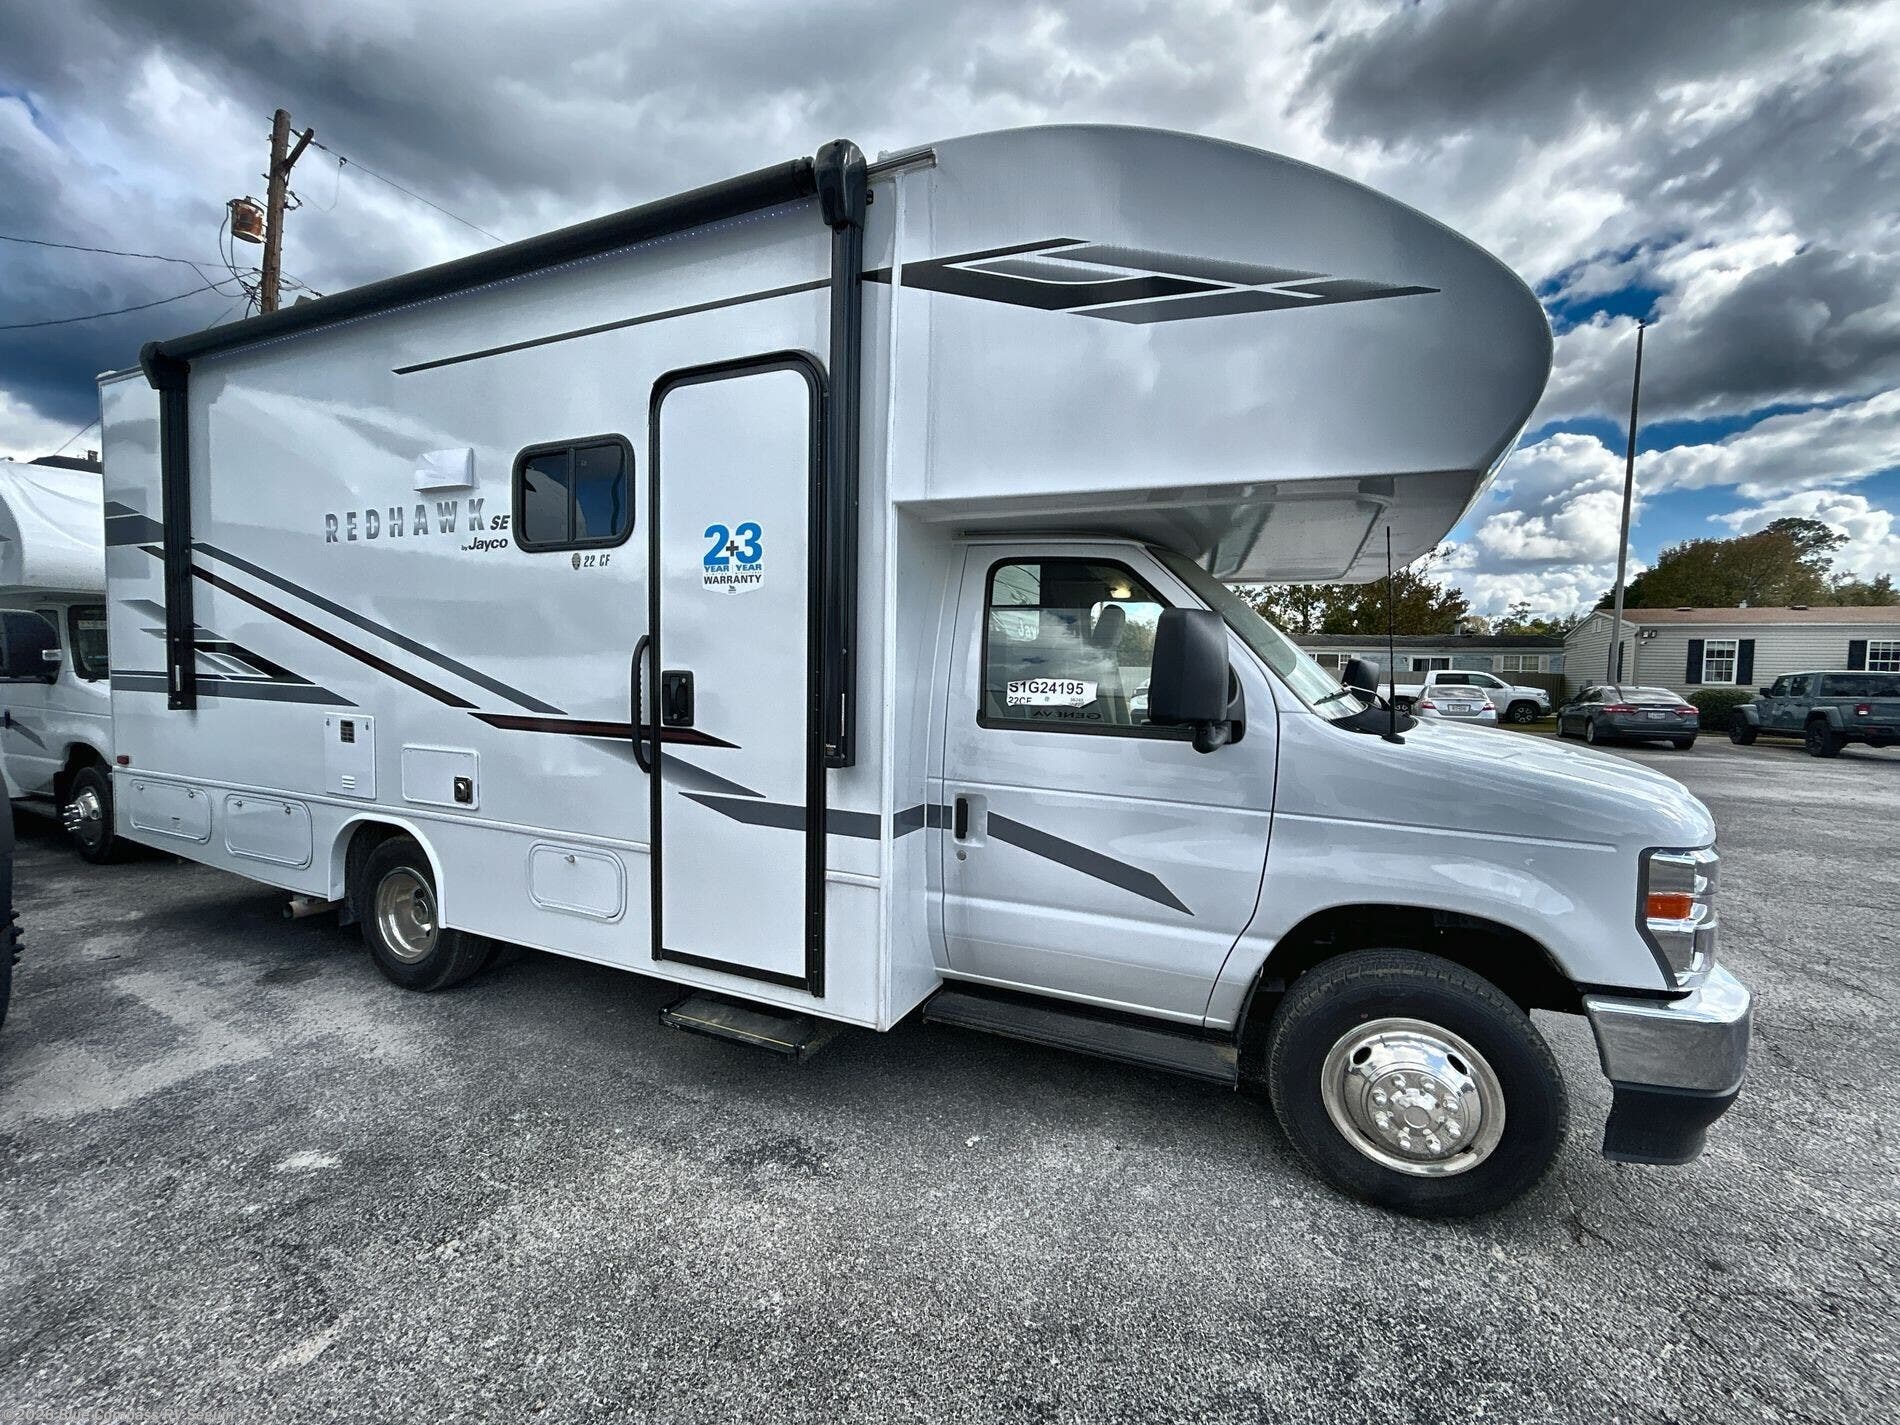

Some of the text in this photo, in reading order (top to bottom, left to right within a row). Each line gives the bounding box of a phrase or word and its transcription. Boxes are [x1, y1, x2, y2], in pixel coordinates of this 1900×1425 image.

[325, 498, 511, 543] REDHAWK SE
[468, 537, 508, 552] Jayco
[584, 554, 611, 567] 22 CF
[704, 563, 762, 573] YEAR YEAR
[704, 574, 762, 584] WARRANTY
[1009, 681, 1084, 695] S1G24195
